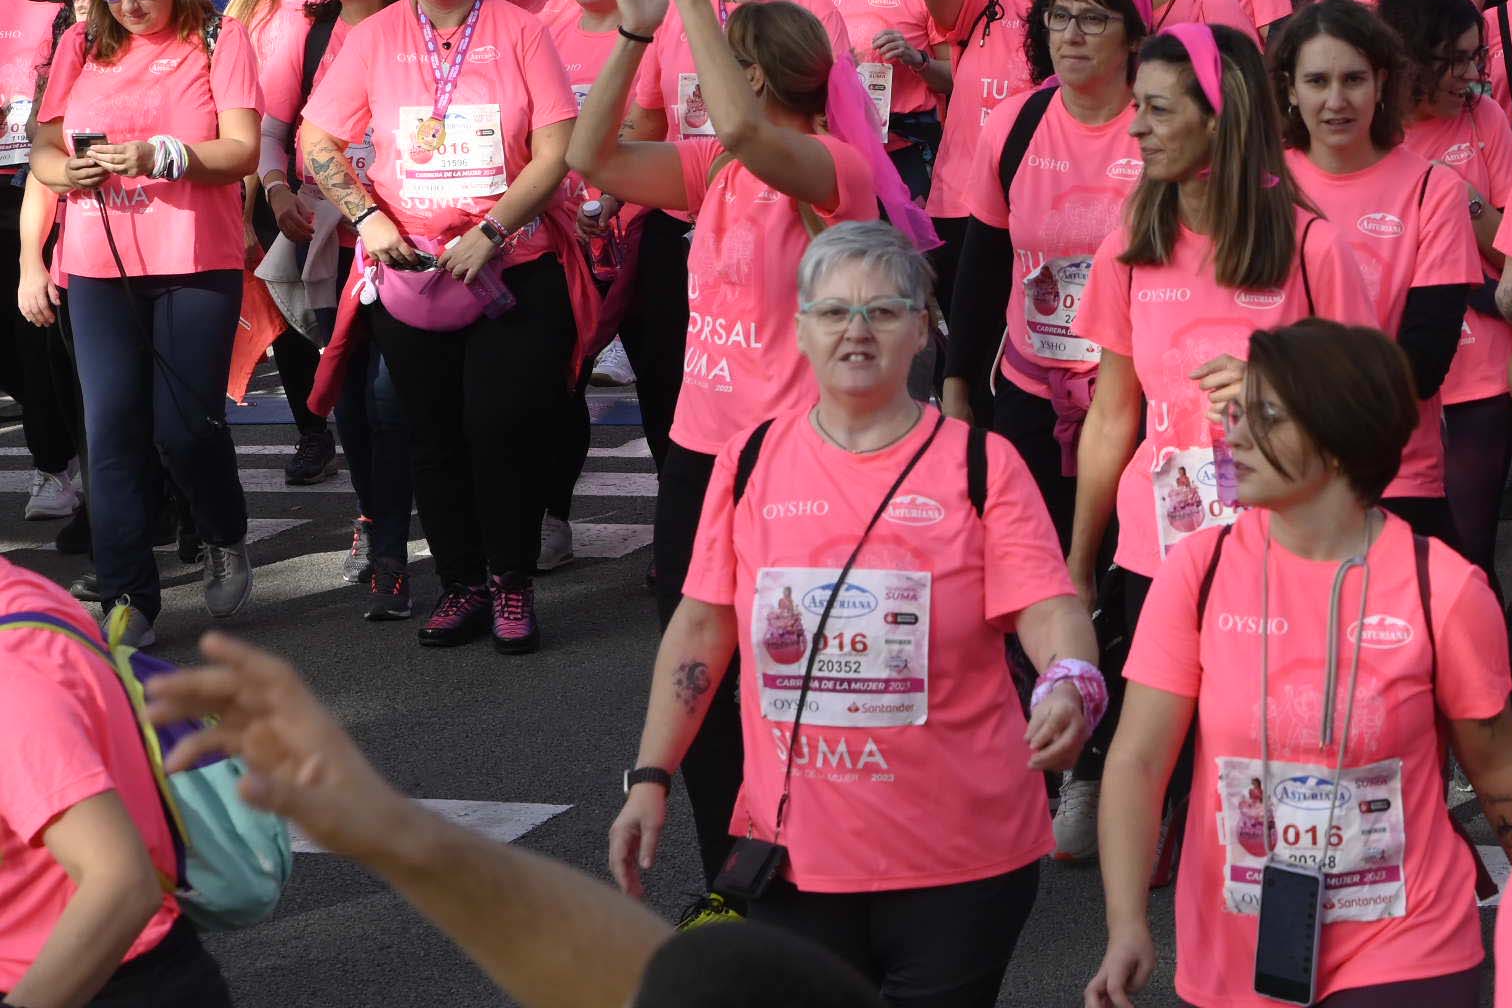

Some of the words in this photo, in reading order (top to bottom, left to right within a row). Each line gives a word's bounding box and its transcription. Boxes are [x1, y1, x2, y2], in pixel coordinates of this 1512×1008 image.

[981, 79, 1008, 99] TU
[1361, 217, 1402, 234] ASTURIANA
[1138, 288, 1191, 302] OYSHO
[1036, 325, 1065, 335] CARRERA
[763, 500, 829, 520] OYSHO
[886, 507, 940, 520] ASTURIANA
[885, 592, 919, 602] SUMA
[817, 660, 862, 674] 20352
[821, 679, 834, 689] DE
[836, 680, 849, 689] LA
[850, 680, 886, 691] MUJER
[861, 702, 914, 714] Santander
[772, 728, 888, 770] SUMA
[1282, 824, 1344, 848] 016
[1337, 894, 1393, 911] Santander
